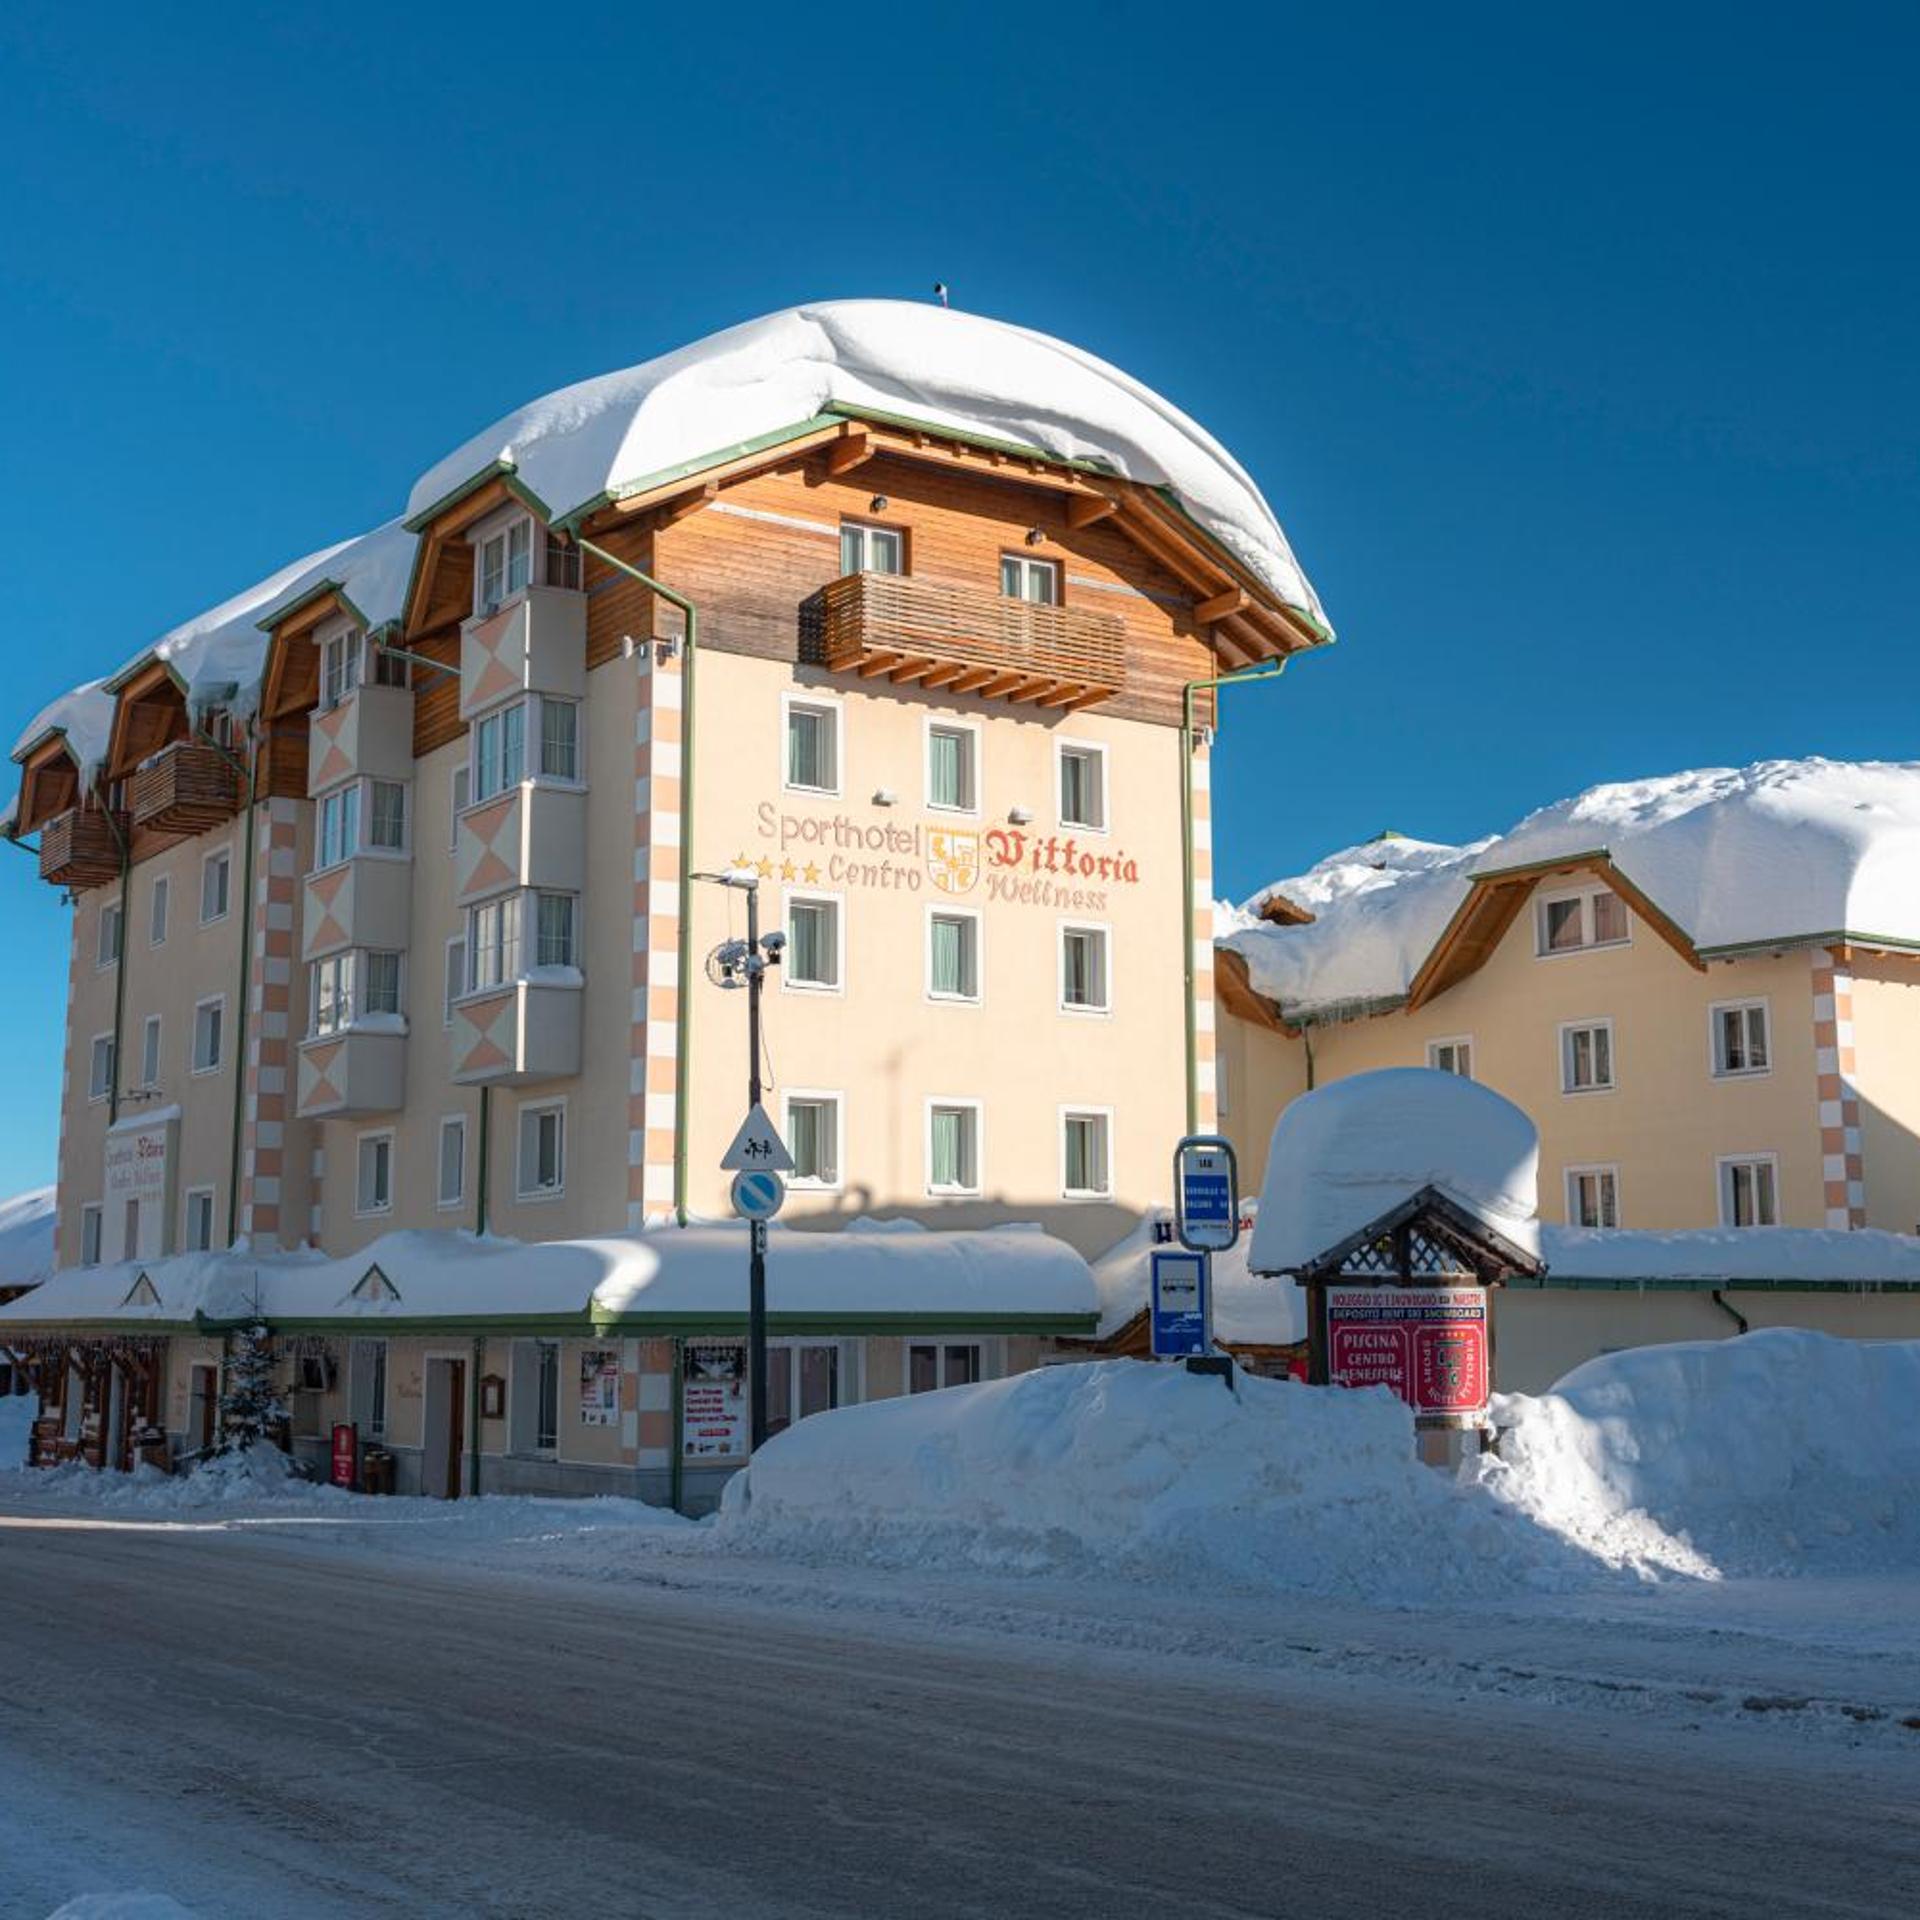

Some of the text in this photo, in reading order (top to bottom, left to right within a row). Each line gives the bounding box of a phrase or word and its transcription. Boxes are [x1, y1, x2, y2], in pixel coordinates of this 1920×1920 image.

[756, 800, 1140, 884] Sporthotel Vittoria
[828, 854, 1108, 912] Centro Wellness
[1343, 1333, 1399, 1349] PISCINA
[1347, 1352, 1396, 1365] CENTRO
